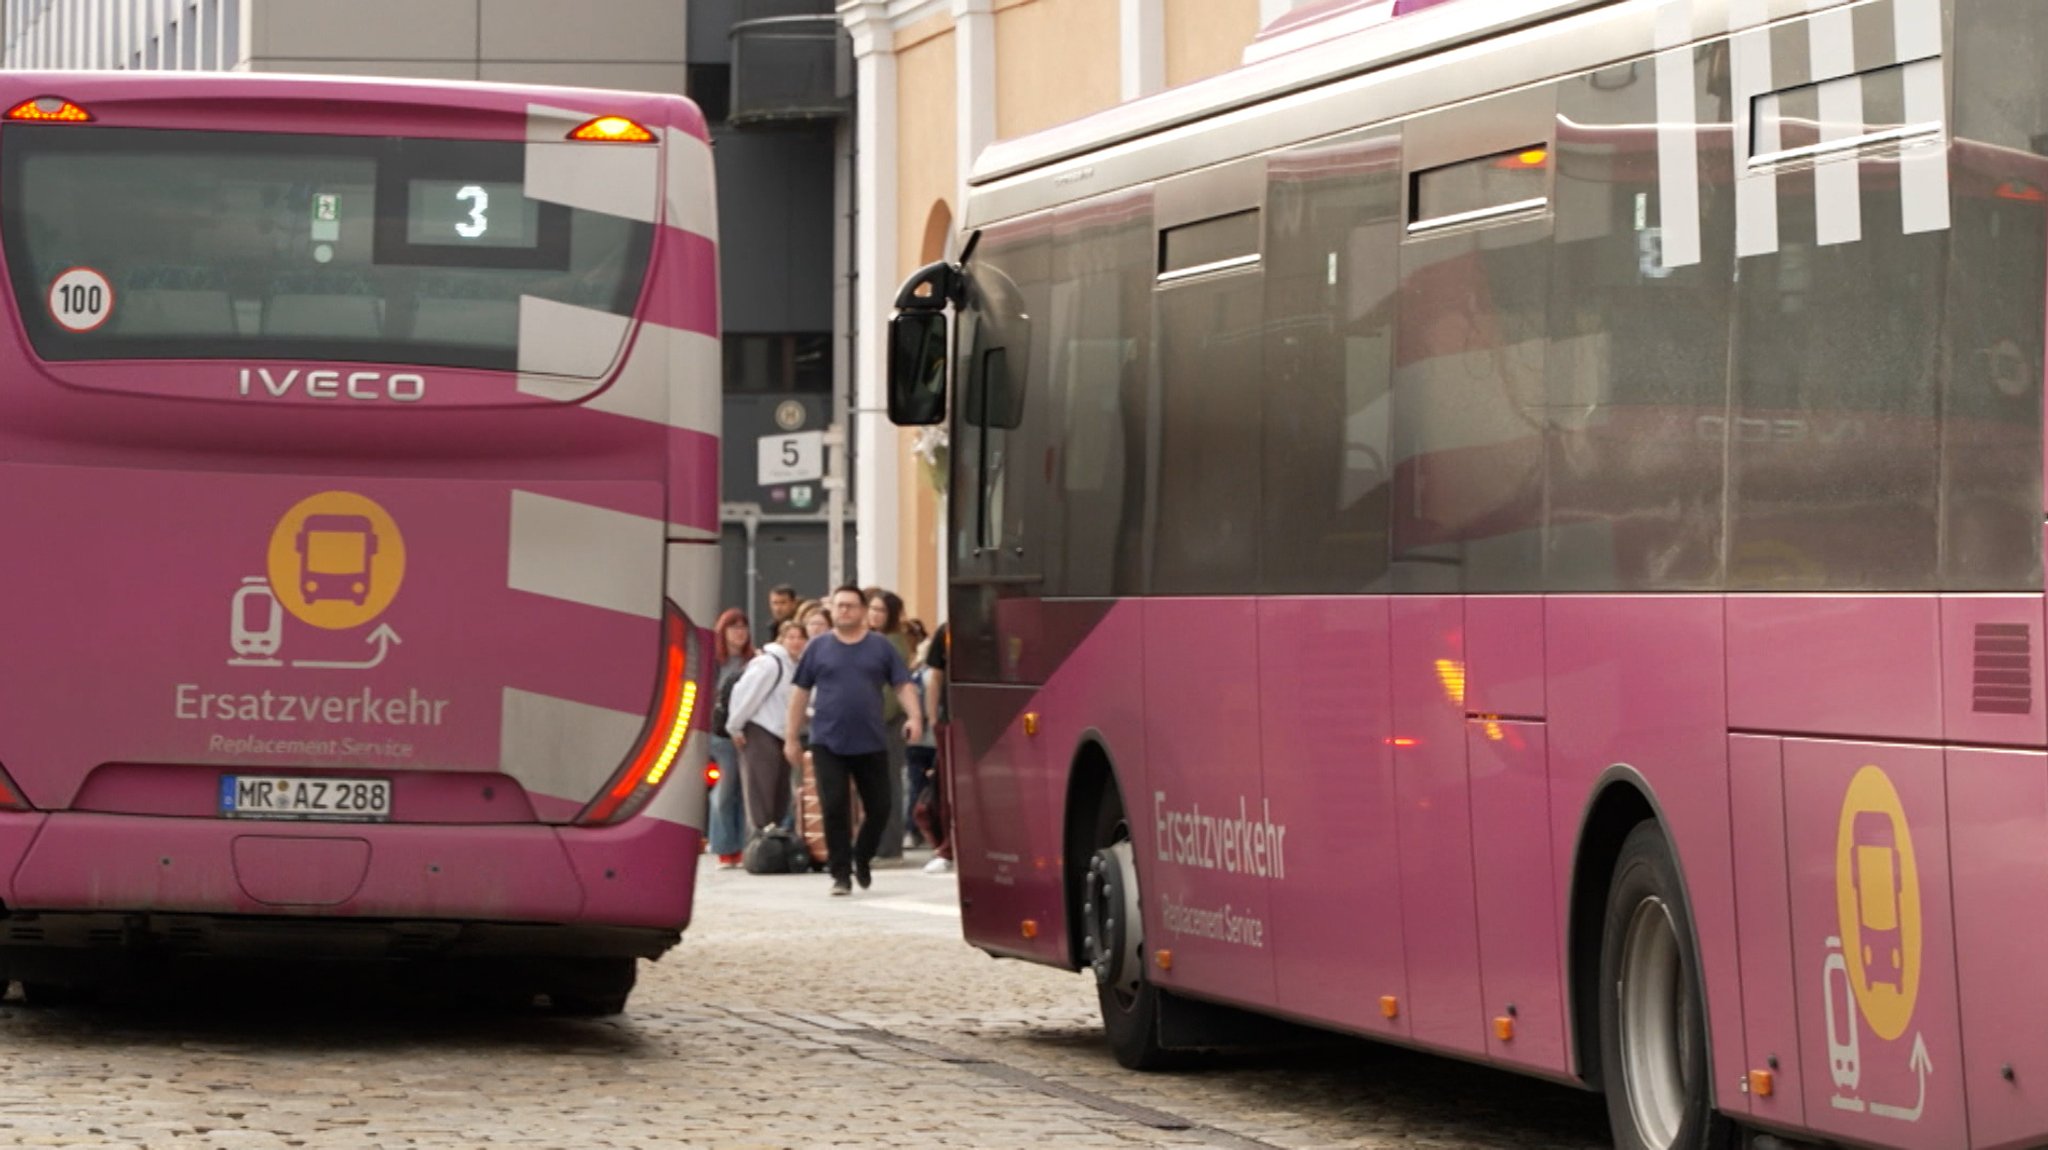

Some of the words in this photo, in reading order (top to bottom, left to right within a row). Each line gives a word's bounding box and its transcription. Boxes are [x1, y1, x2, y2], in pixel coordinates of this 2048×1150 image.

[455, 185, 488, 238] 3
[60, 284, 101, 315] 100
[239, 368, 425, 402] IVECO
[782, 440, 799, 467] 5
[175, 684, 448, 726] Ersatzverkehr
[208, 734, 337, 756] Replacement
[341, 737, 413, 758] Service
[239, 780, 273, 807] MR
[294, 782, 328, 809] AZ
[335, 783, 385, 811] 288
[1154, 791, 1285, 880] Ersatzverkehr
[1161, 893, 1224, 940] Replacement
[1224, 904, 1264, 947] Service
